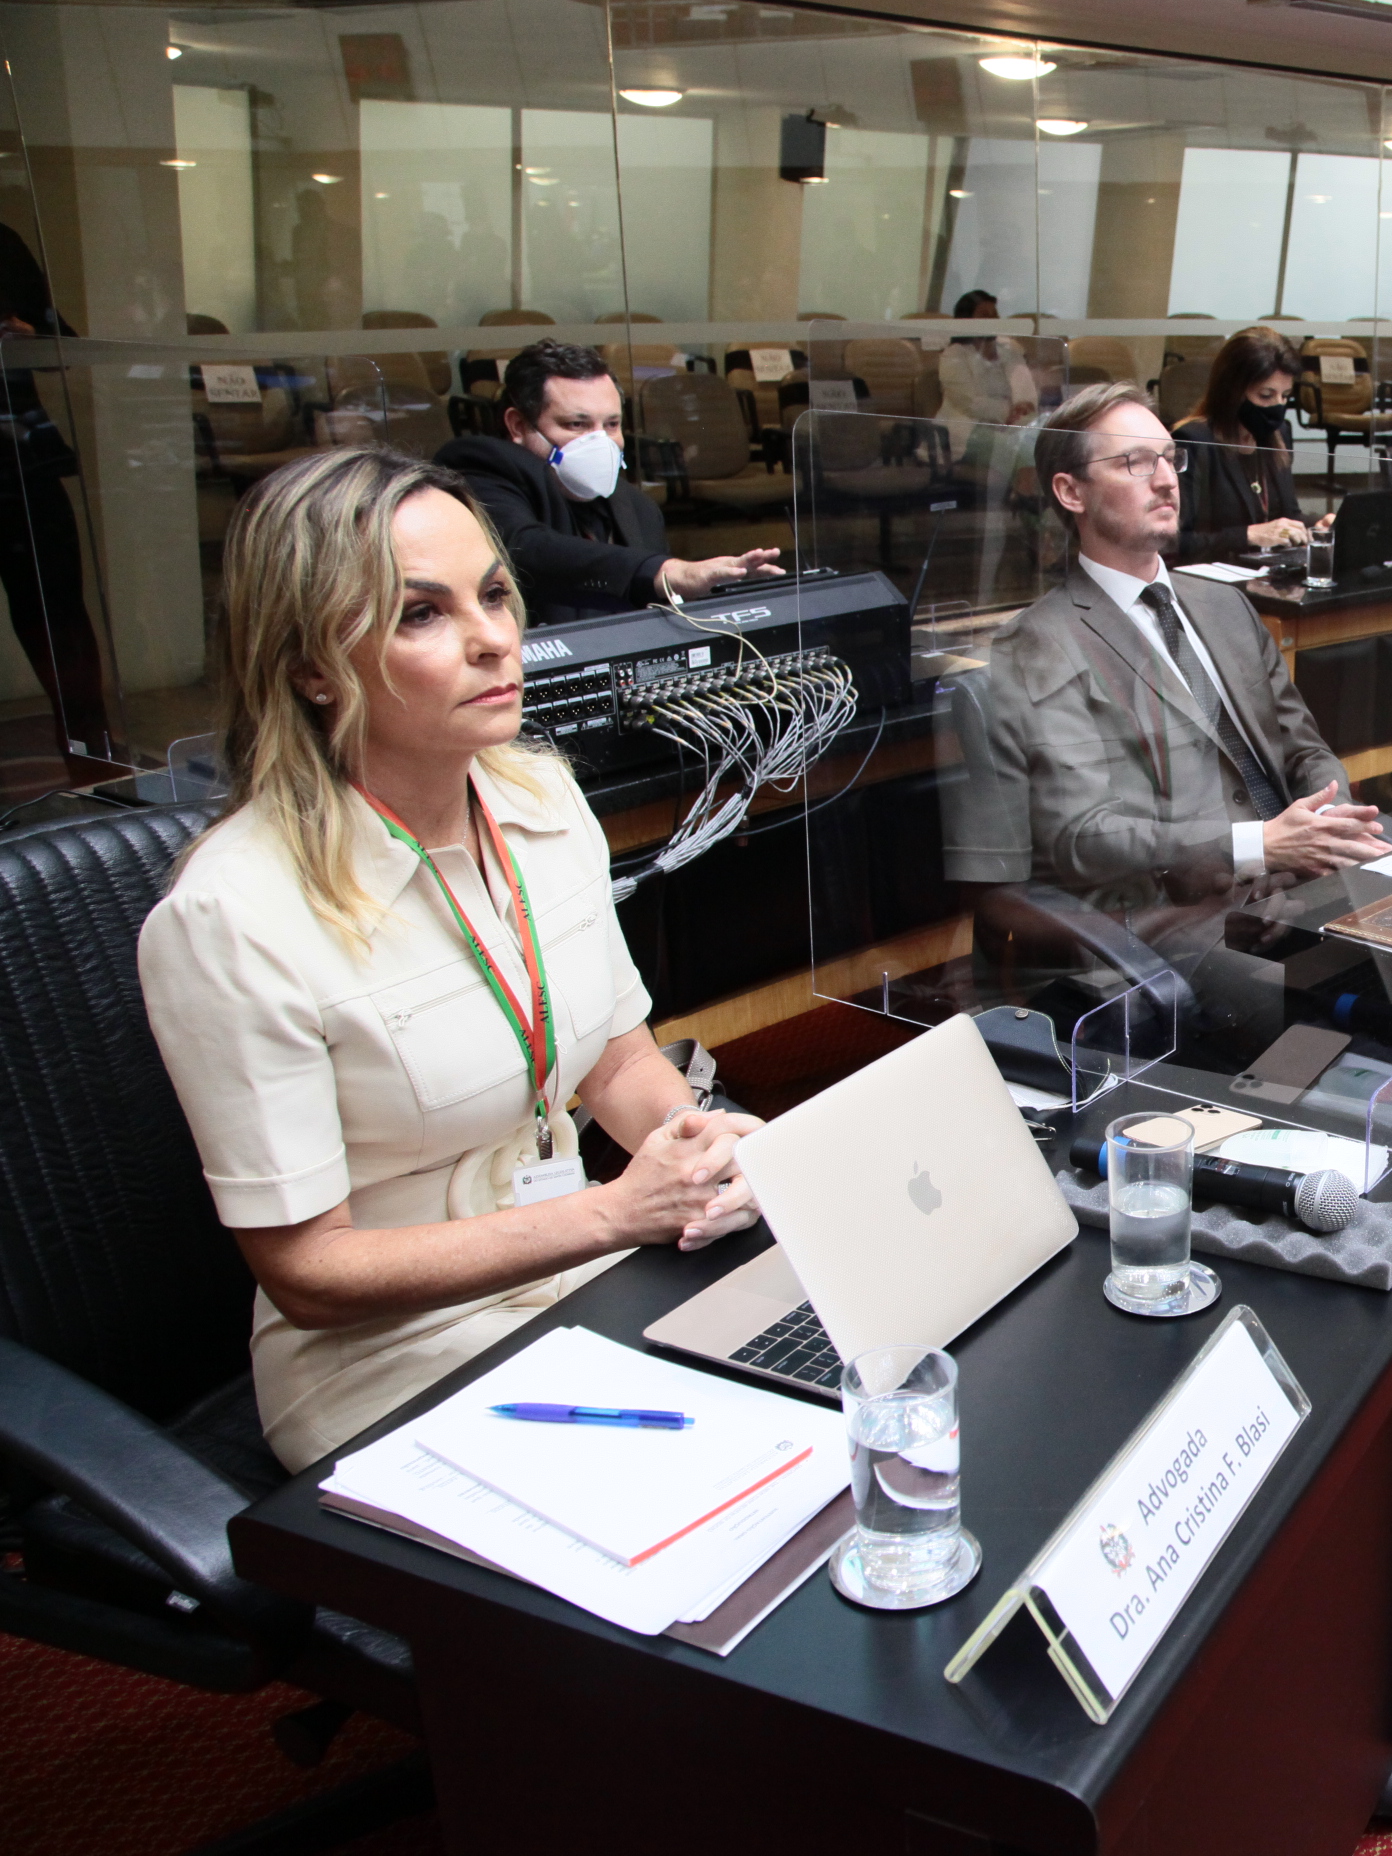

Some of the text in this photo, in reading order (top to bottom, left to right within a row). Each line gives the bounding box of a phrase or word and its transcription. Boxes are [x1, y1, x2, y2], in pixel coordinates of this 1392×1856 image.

[711, 606, 772, 624] TF5
[521, 639, 573, 665] MAHA
[535, 981, 550, 1024] ALESC
[518, 1029, 535, 1064] ALES
[1135, 1426, 1209, 1527] Advogada
[1108, 1405, 1272, 1642] Dra. Ana Cristina F. Blasi
